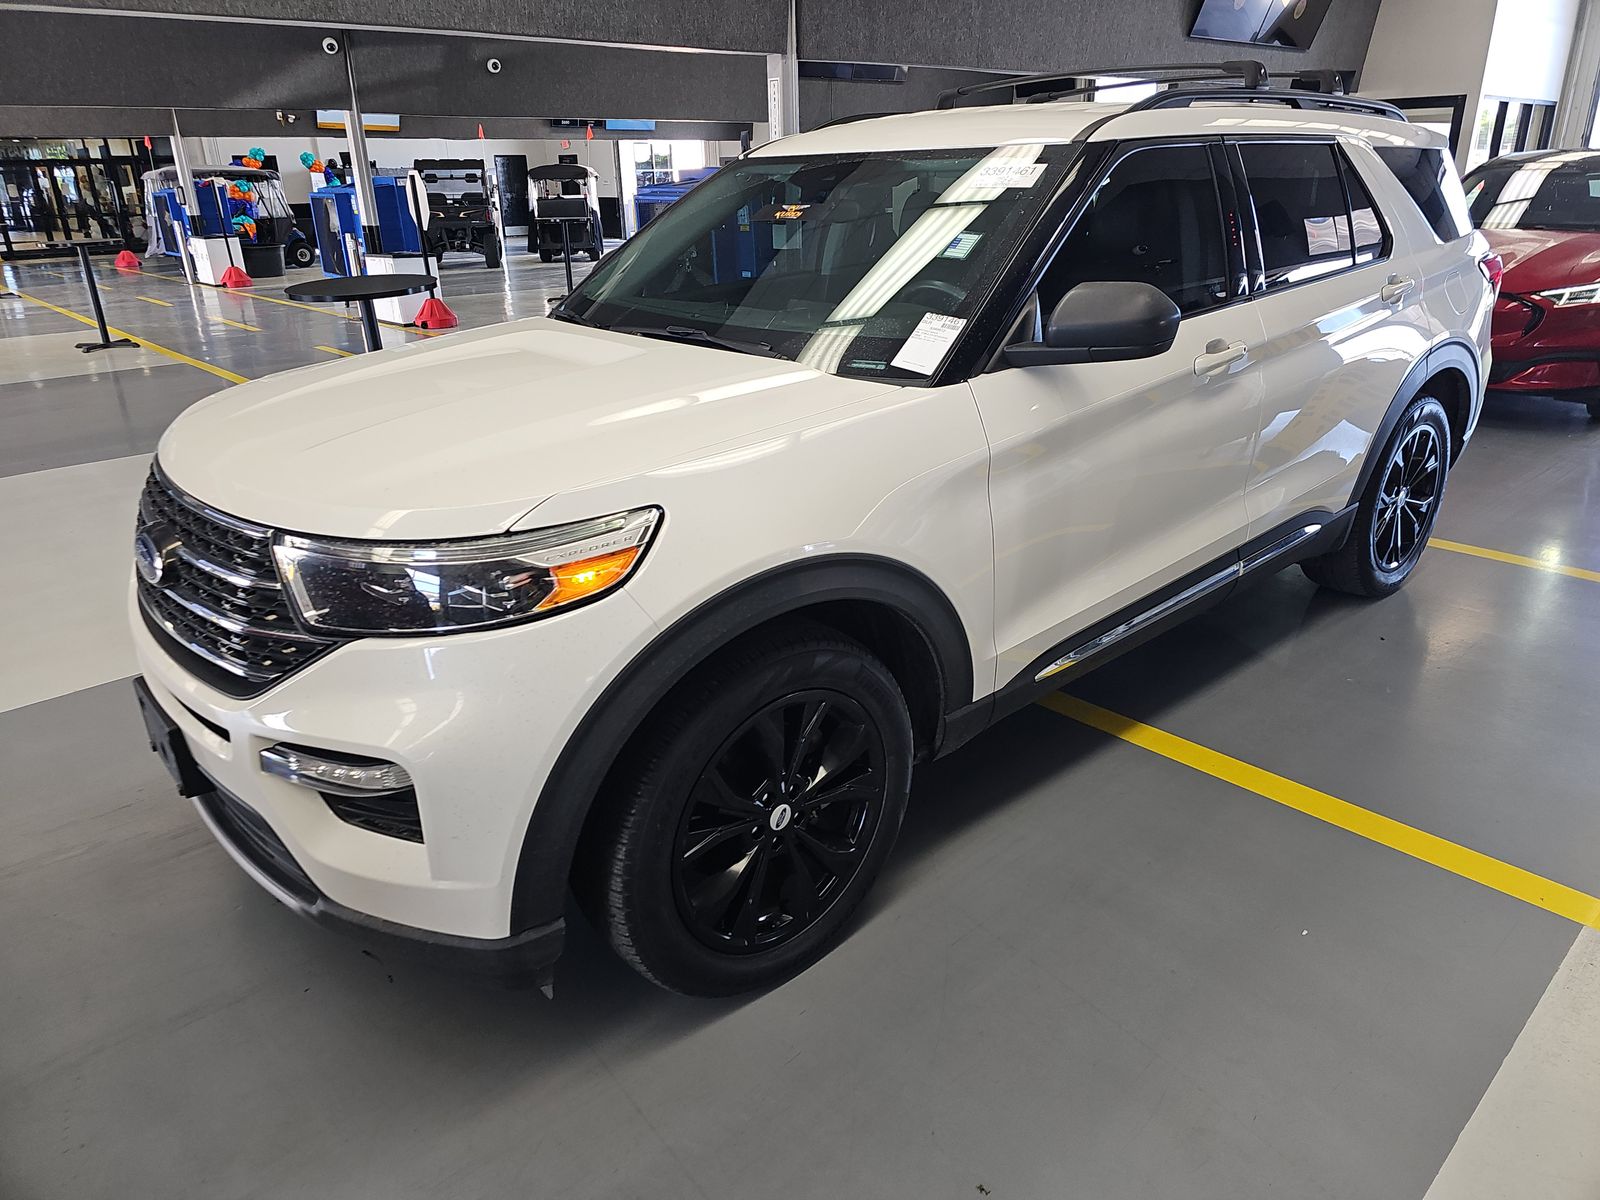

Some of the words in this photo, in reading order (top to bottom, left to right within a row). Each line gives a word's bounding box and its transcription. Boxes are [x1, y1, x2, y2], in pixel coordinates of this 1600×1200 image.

[980, 166, 1037, 176] 3391461
[926, 313, 965, 326] 3391461
[544, 535, 633, 561] EXPLORER
